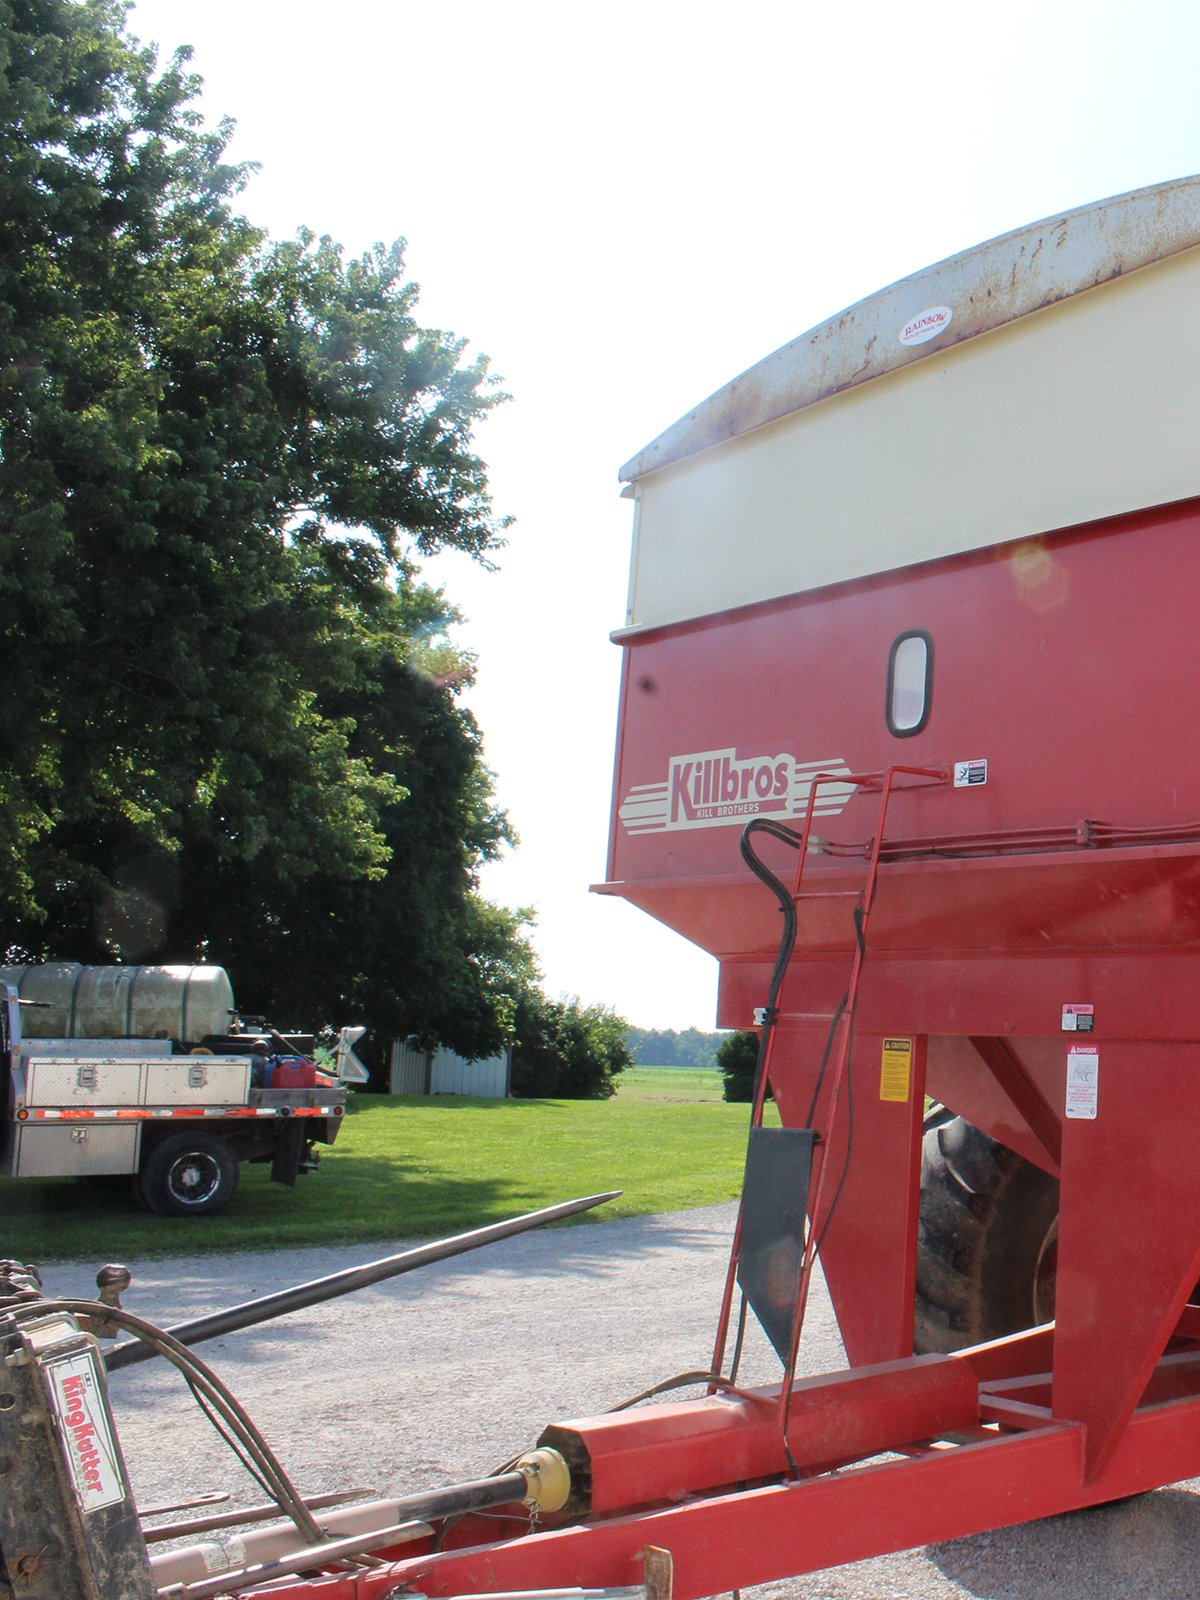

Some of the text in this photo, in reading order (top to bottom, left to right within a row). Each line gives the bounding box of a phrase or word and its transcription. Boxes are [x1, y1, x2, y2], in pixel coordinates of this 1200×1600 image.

[904, 312, 948, 337] RAINBOW
[671, 757, 789, 823] Killbros
[697, 803, 760, 818] KILL BROTHERS
[891, 1041, 910, 1050] CAUTION
